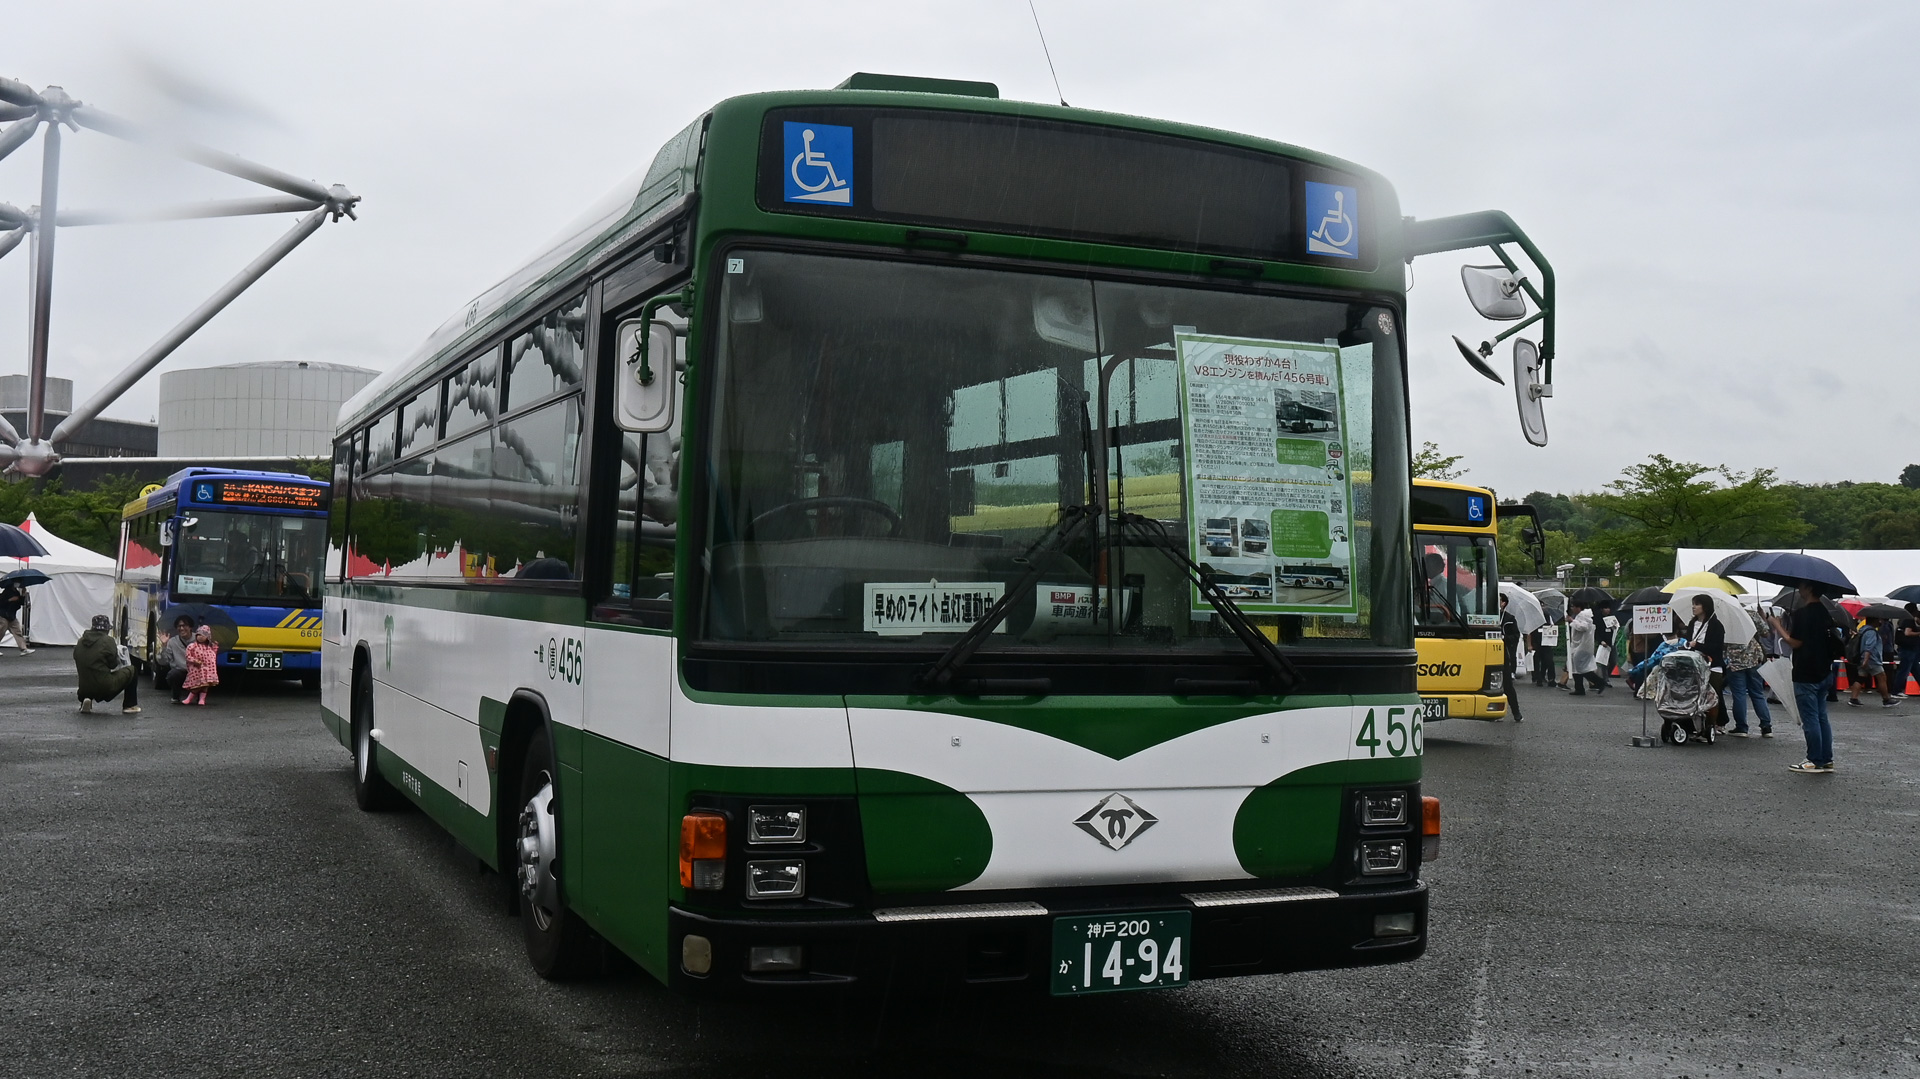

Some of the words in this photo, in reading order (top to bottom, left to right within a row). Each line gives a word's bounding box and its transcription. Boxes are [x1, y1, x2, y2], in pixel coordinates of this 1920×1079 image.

[732, 263, 738, 272] 7
[1224, 353, 1298, 370] 現役わずか4台！
[1194, 366, 1329, 386] V8エンジンを積んだ「456号車」
[1054, 592, 1072, 600] BMP
[875, 592, 995, 624] 早めのライト点灯運動中
[559, 637, 582, 685] 456
[1356, 707, 1422, 757] 456
[1087, 919, 1150, 938] 神戸200
[1058, 959, 1072, 974] か
[1083, 936, 1183, 988] 14-94
